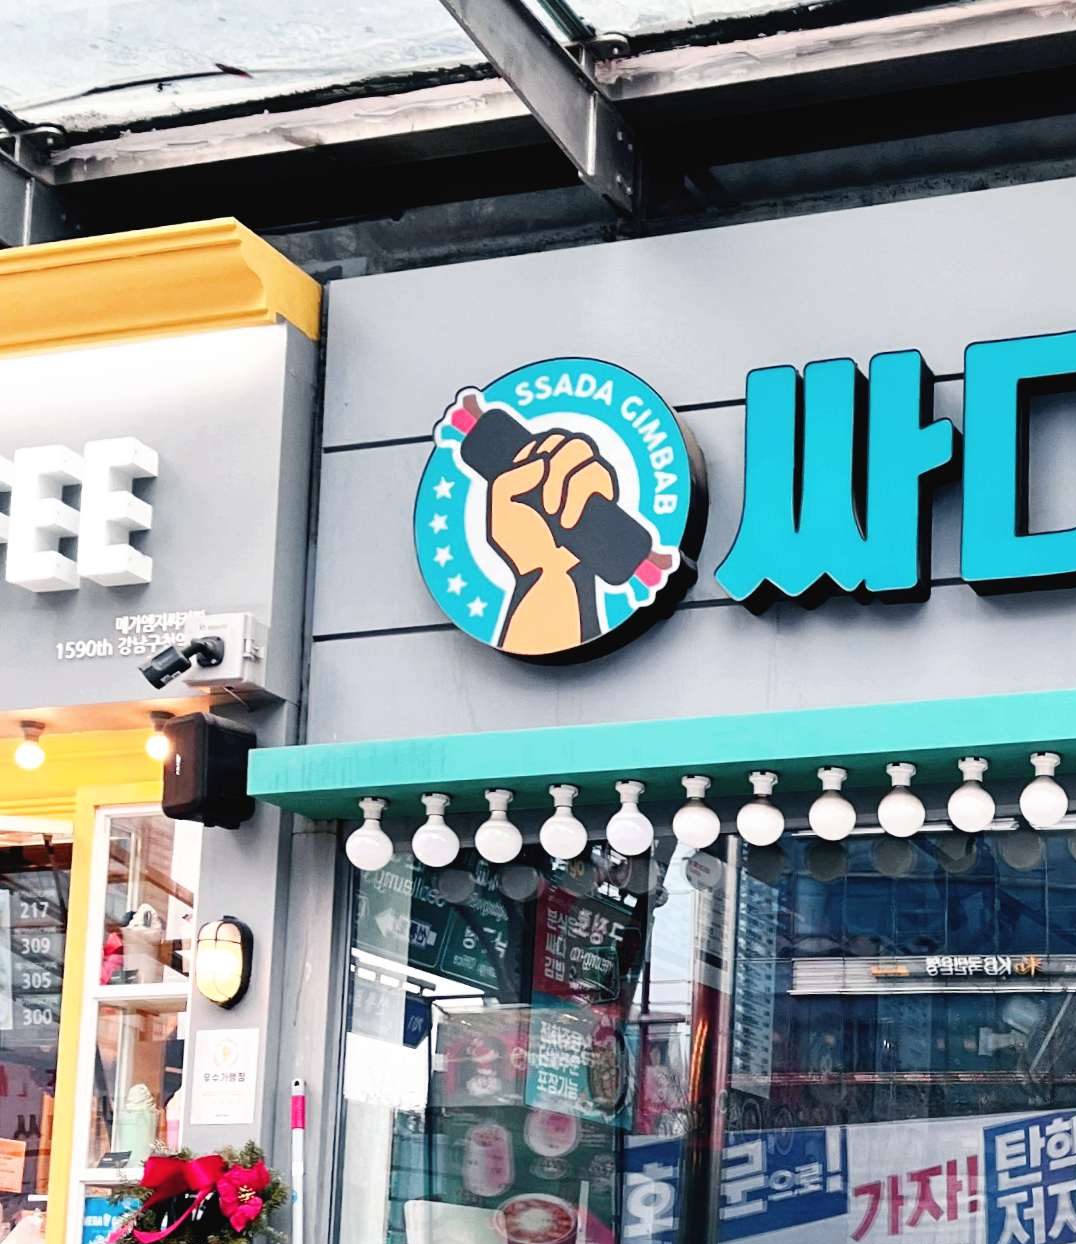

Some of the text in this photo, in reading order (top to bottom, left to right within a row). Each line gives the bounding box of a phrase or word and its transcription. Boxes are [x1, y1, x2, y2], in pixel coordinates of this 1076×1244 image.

[515, 372, 678, 516] SSADA GIMBAB
[0, 436, 158, 592] EE
[56, 638, 114, 660] 1590th
[20, 902, 49, 919] 217
[21, 937, 51, 954] 309
[22, 971, 52, 989] 305
[22, 1008, 53, 1026] 300
[851, 1154, 980, 1242] 가자!
